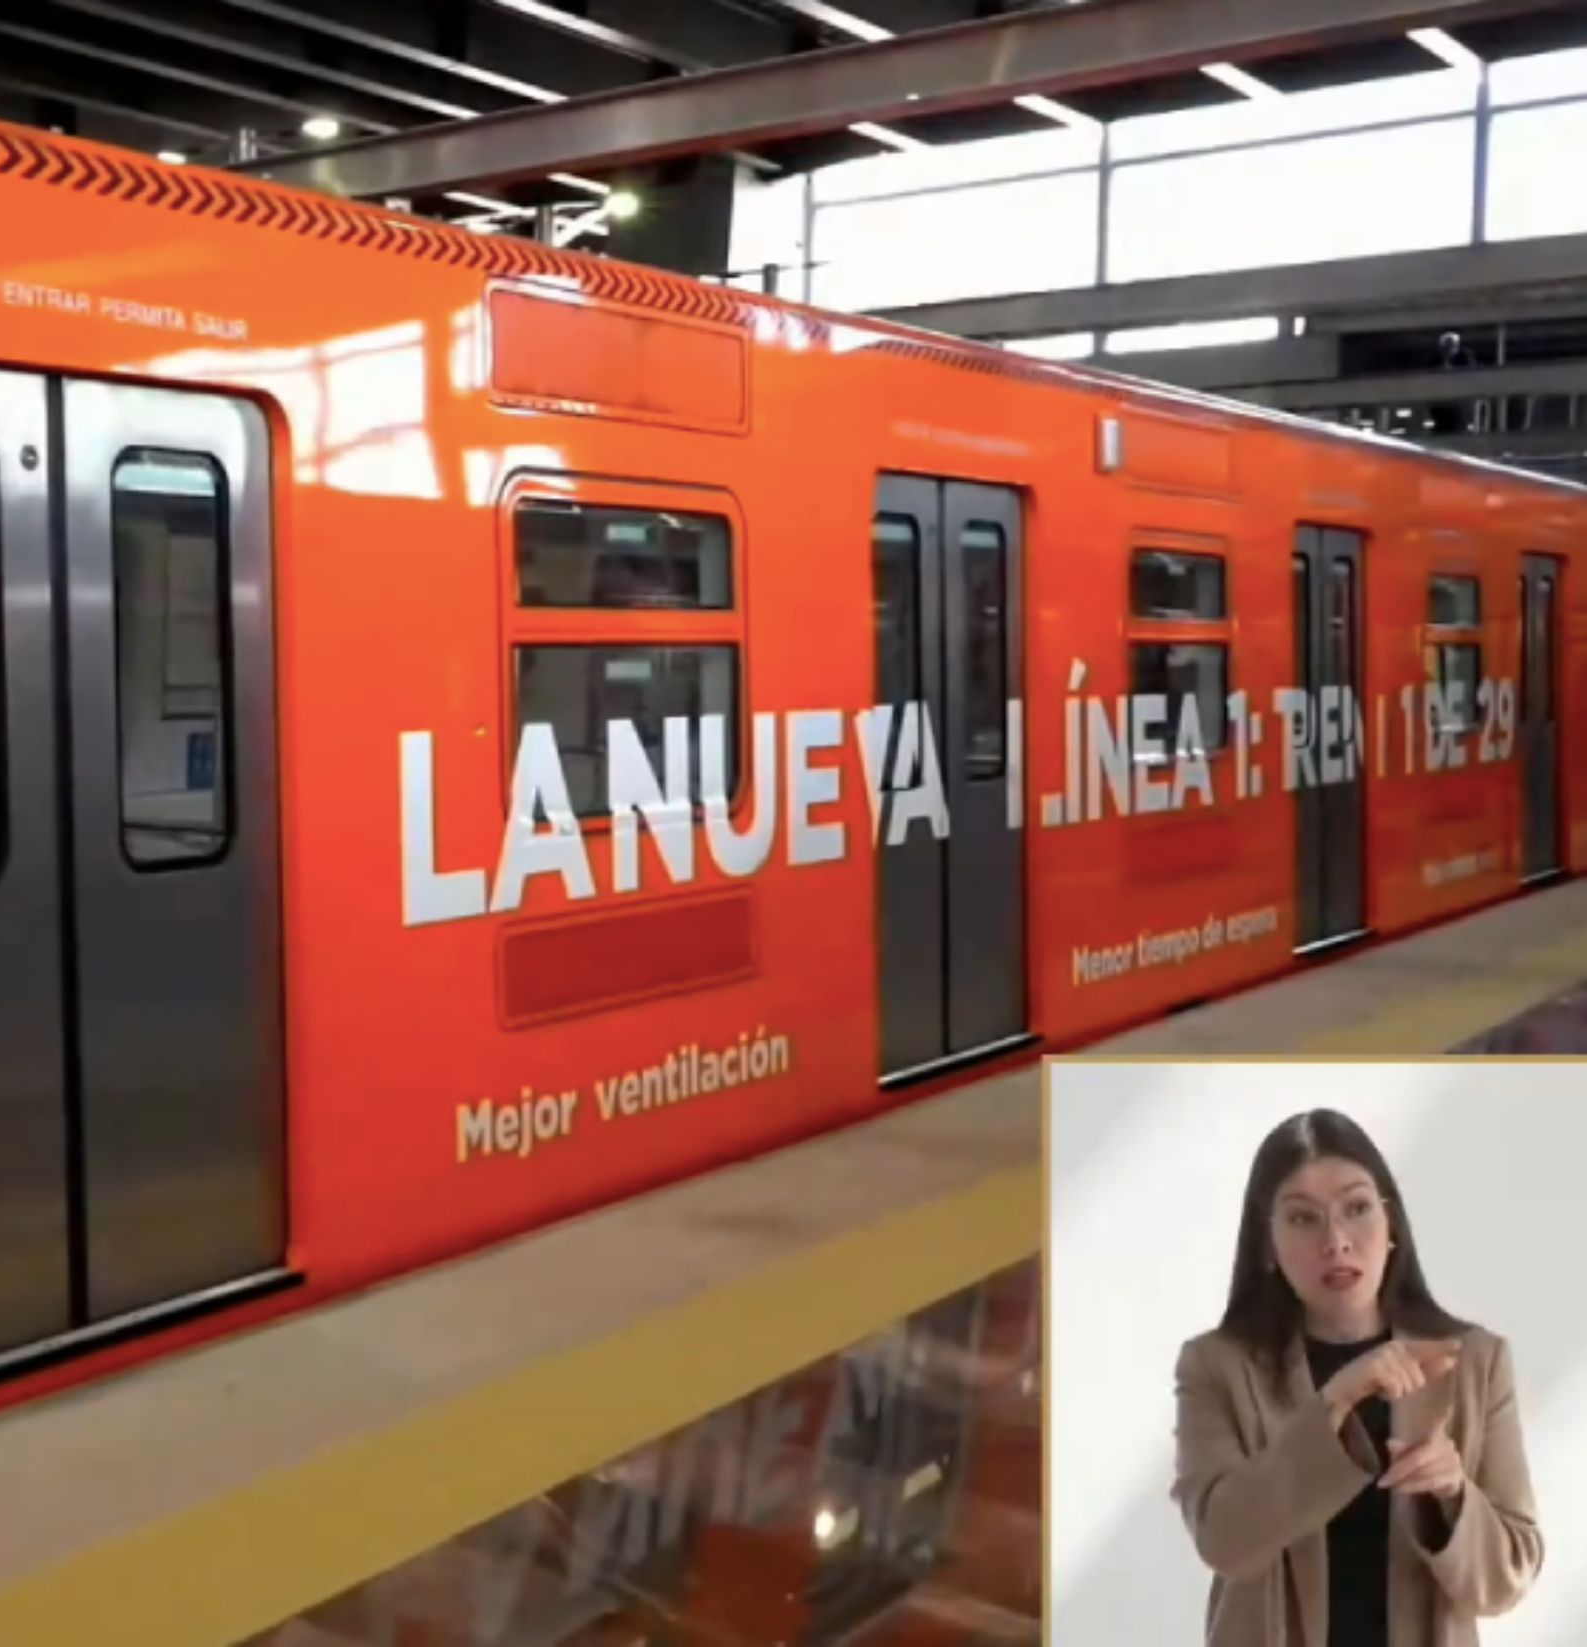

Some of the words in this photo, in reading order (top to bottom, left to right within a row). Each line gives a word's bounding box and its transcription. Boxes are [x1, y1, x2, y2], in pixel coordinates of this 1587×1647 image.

[4, 280, 91, 315] ENTRAR
[100, 296, 185, 331] PERMITA
[192, 311, 248, 340] SALIR
[399, 721, 597, 928] LA
[606, 698, 951, 894] NUEVA
[1005, 657, 1214, 830] LÍNEA
[1424, 679, 1467, 773] DE
[1476, 676, 1518, 764] 29
[1072, 941, 1134, 987] Menor
[1138, 926, 1200, 968] tiempo
[1201, 911, 1224, 949] de
[455, 1089, 577, 1162] Mejor
[595, 1024, 789, 1120] ventilación
